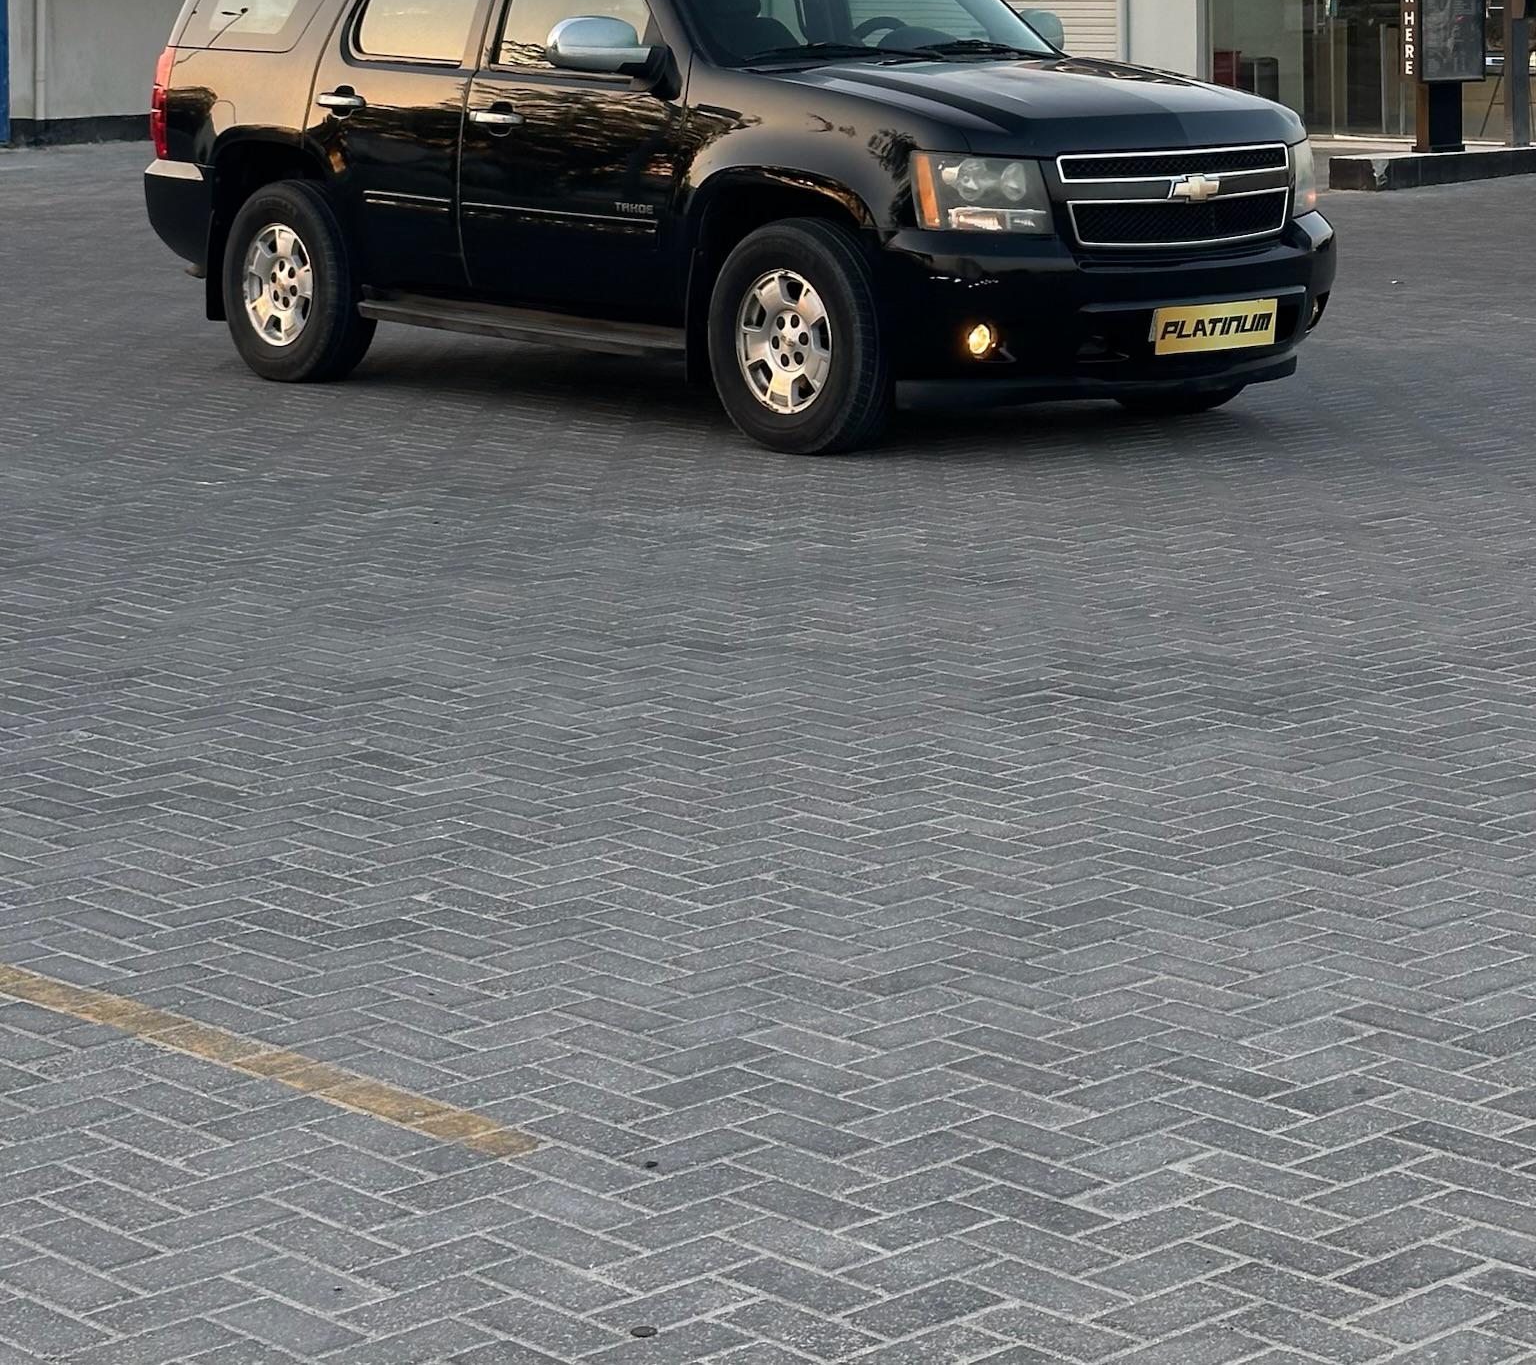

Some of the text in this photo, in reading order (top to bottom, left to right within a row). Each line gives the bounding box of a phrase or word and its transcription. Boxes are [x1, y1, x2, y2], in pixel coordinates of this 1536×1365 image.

[1404, 11, 1415, 75] HERE
[614, 201, 654, 215] TAHOE
[1160, 312, 1273, 340] PLATINUM
